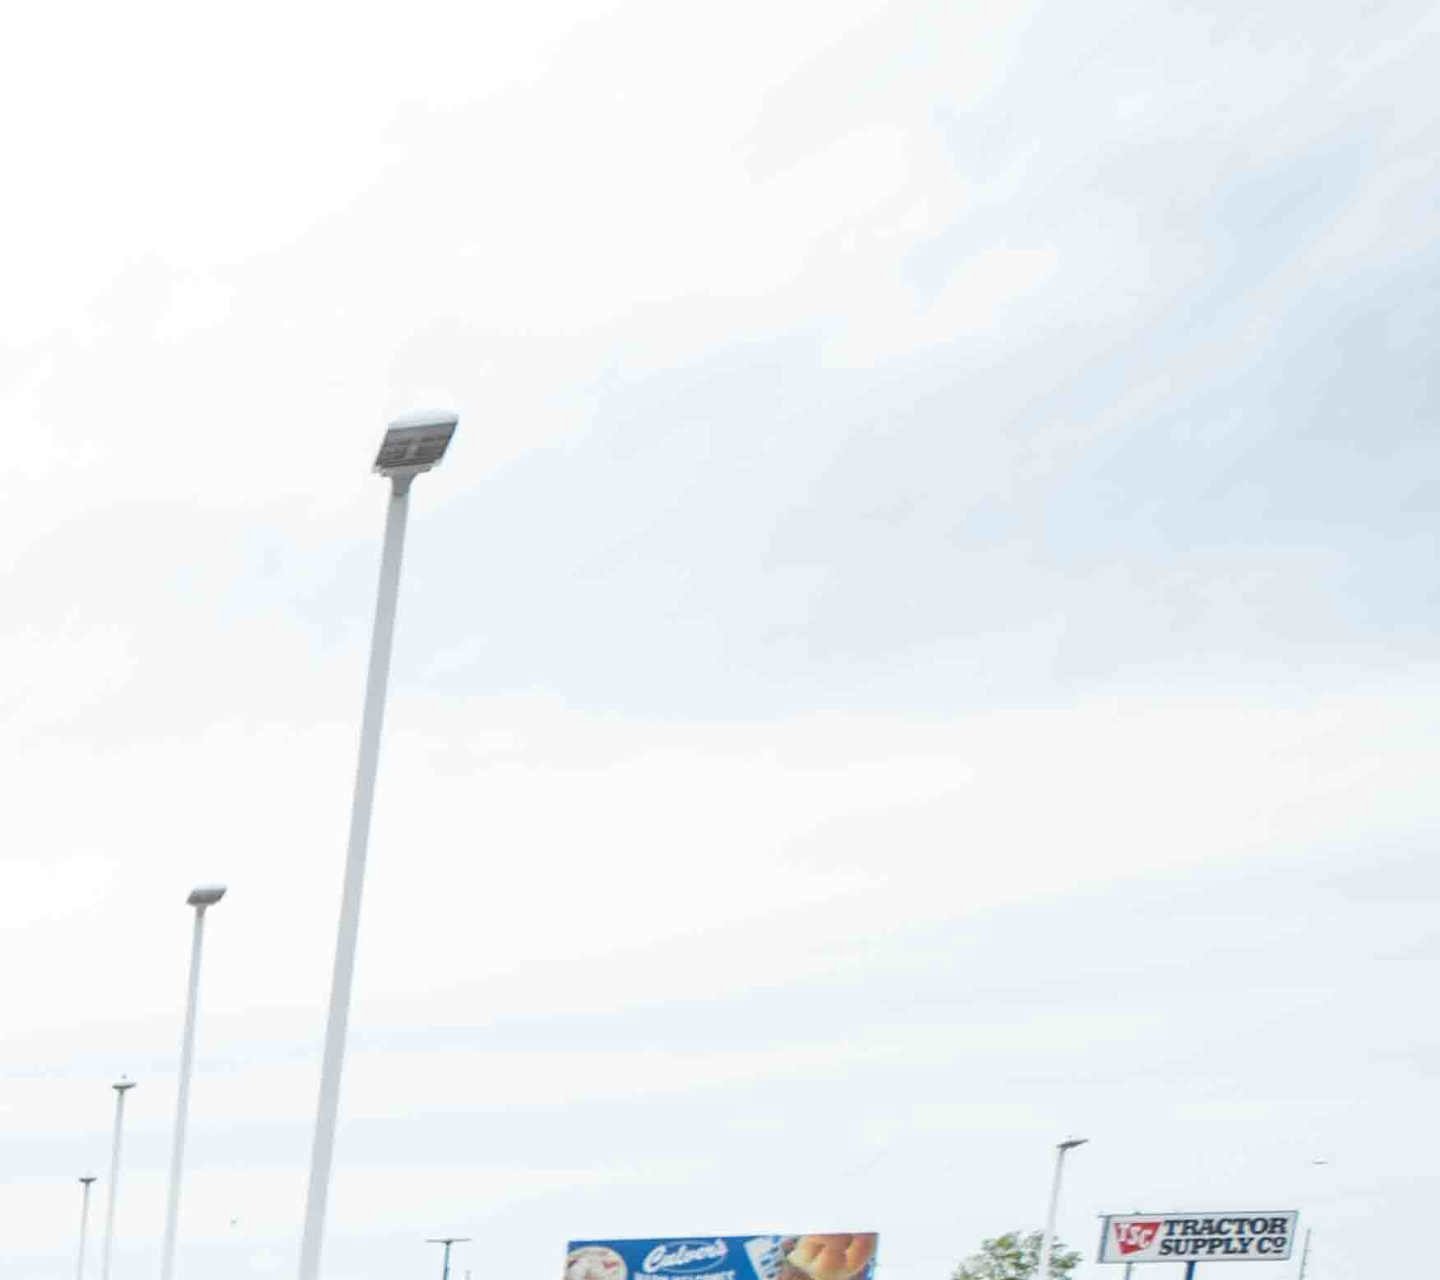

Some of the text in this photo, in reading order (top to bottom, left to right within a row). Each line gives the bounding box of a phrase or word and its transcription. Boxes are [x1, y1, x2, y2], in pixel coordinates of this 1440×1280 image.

[1120, 1223, 1155, 1249] TSC
[1163, 1217, 1288, 1236] TRACTOR
[1158, 1237, 1254, 1256] SUPPLY
